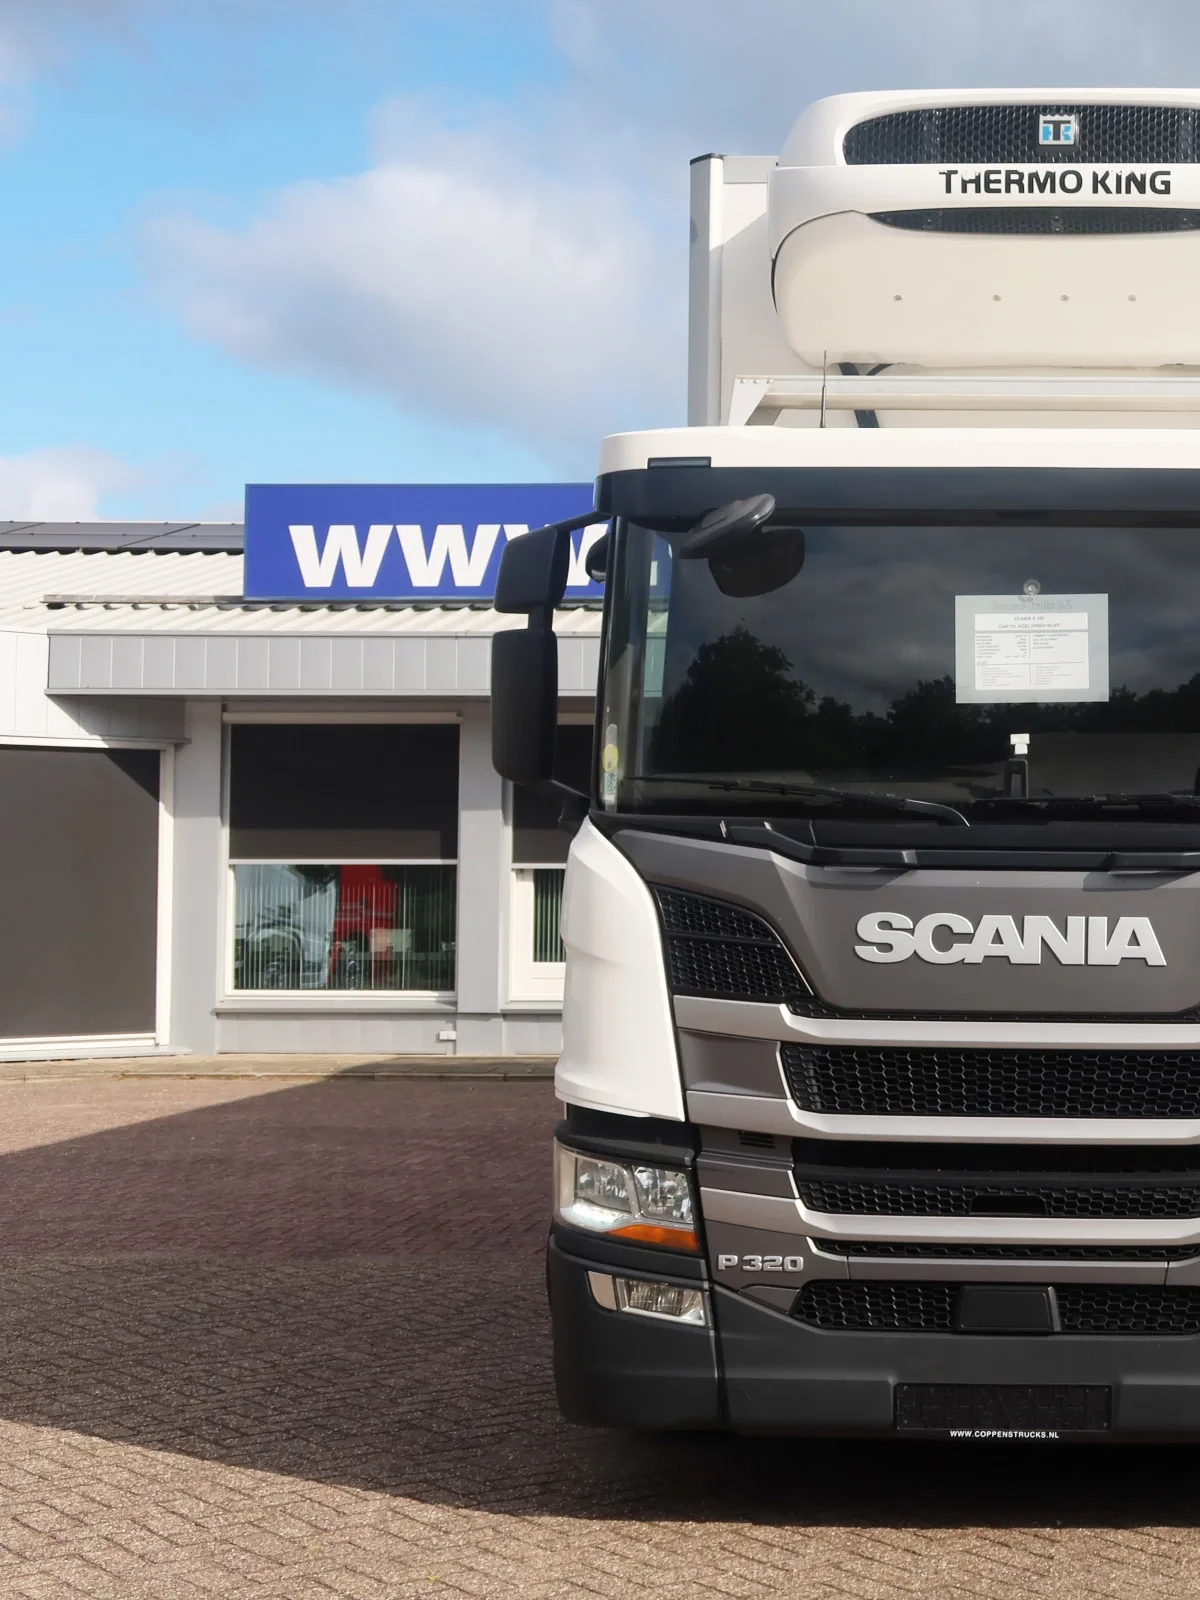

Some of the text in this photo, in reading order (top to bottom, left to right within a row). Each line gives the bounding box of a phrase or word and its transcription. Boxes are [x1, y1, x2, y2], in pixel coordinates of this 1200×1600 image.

[939, 169, 1171, 195] THERMO KING
[854, 911, 1168, 967] SCANIA
[717, 1254, 804, 1272] P 320
[949, 1430, 1060, 1439] WWW.COPPENSTRUCKS.NL
